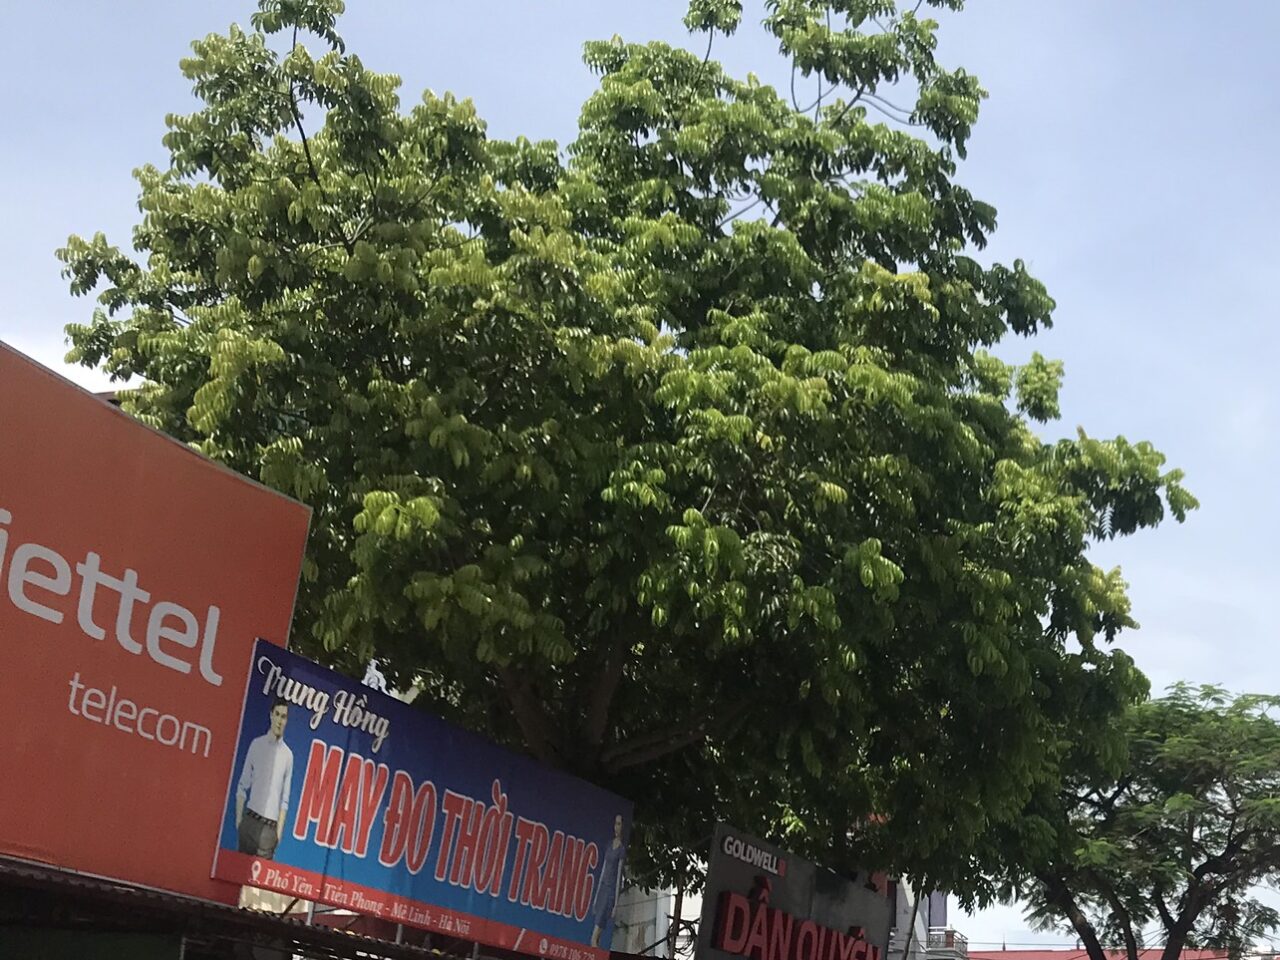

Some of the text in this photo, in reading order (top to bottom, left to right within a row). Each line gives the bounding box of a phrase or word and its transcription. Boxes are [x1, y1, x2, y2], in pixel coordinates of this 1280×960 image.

[68, 672, 212, 758] telecom
[257, 656, 390, 753] Trung Hồng
[293, 739, 599, 922] MAY ĐO THỜI TRANG
[723, 835, 779, 875] GOLDWELL
[264, 868, 289, 889] Phố
[351, 891, 383, 917] Phong
[407, 906, 431, 926] Linh
[439, 914, 452, 931] Hà
